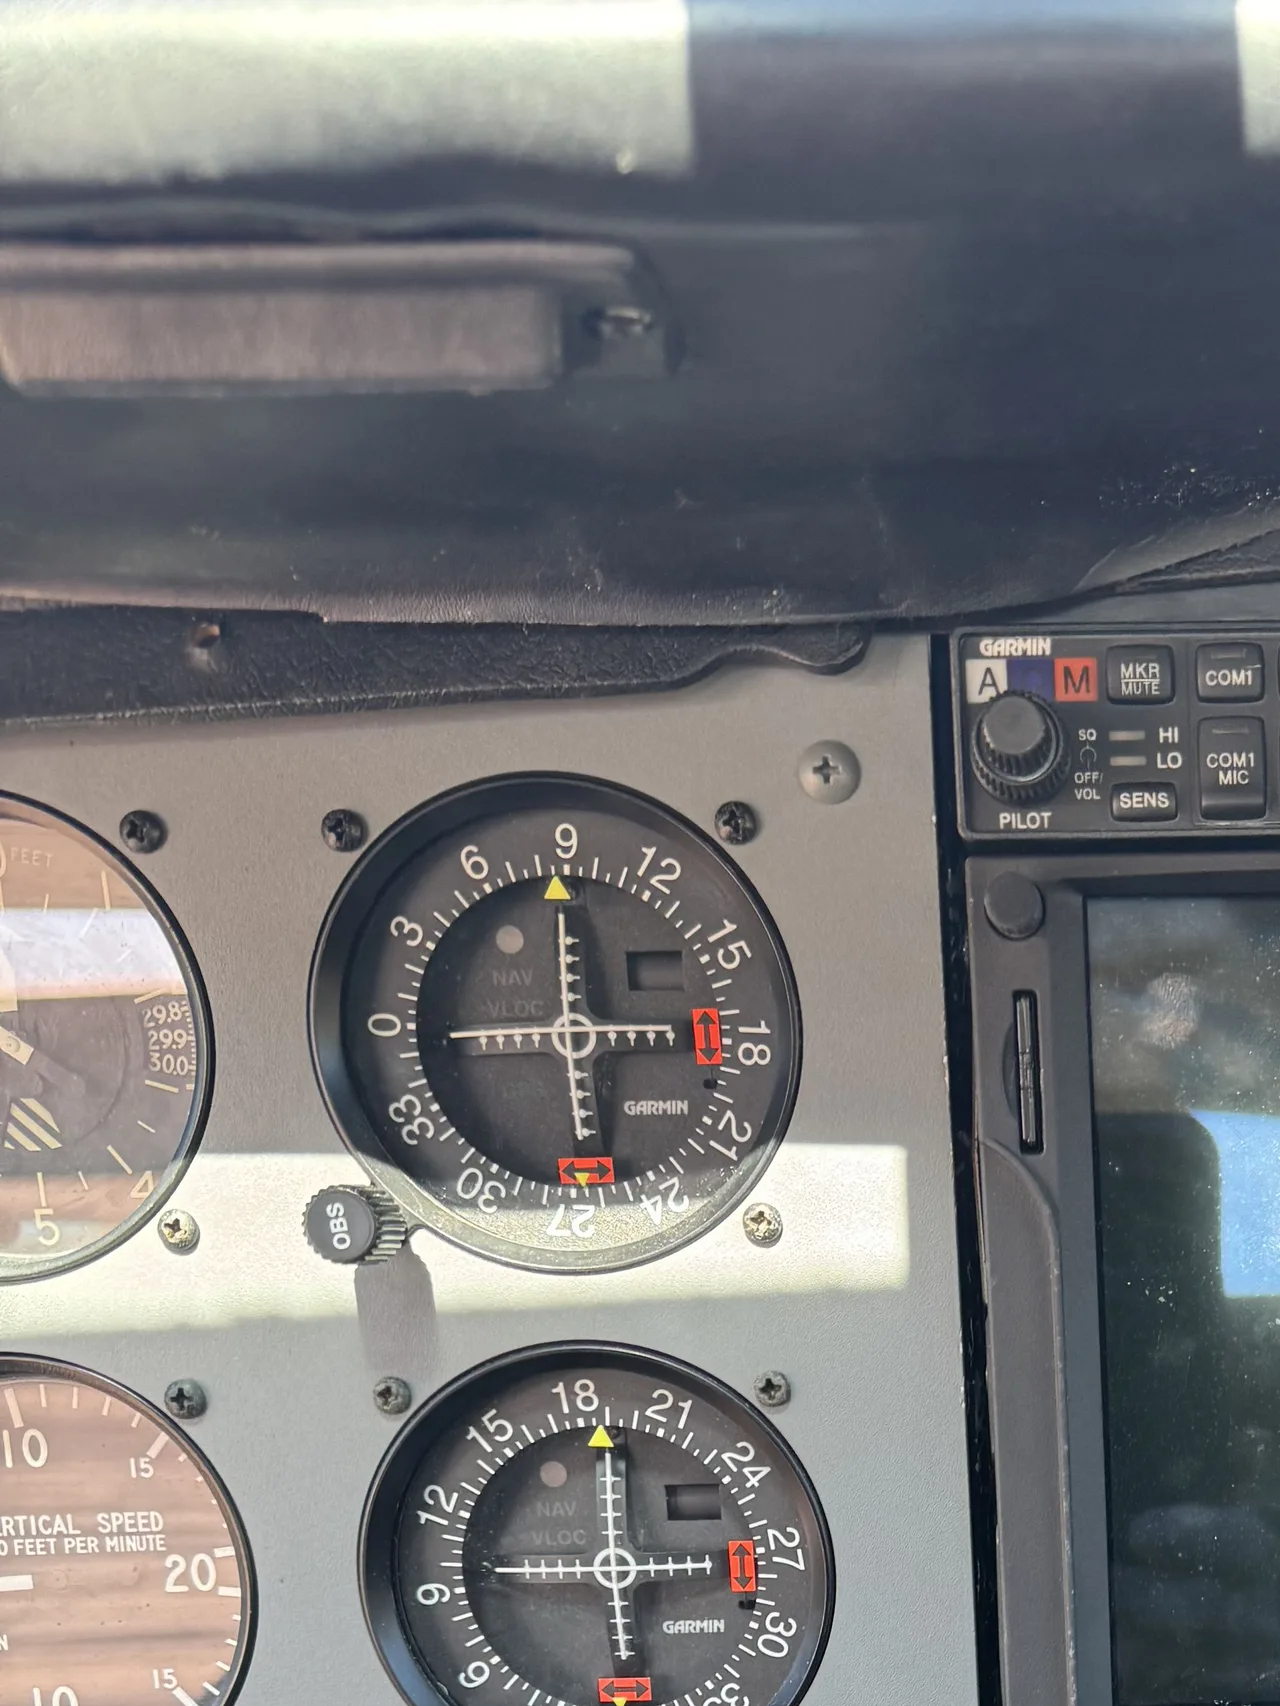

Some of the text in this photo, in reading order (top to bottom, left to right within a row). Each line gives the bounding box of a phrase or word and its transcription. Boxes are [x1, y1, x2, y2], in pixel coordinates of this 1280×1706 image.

[980, 638, 1051, 656] GARMIN
[1063, 666, 1091, 693] M
[1120, 664, 1160, 679] MKR
[1205, 670, 1253, 686] COM1
[978, 668, 999, 695] A
[1120, 680, 1160, 695] MUTE
[1159, 727, 1179, 743] HI
[1157, 753, 1182, 769] LO
[1074, 789, 1100, 800] VOL
[1119, 793, 1169, 808] SENS
[999, 812, 1051, 829] PILOT
[147, 1029, 188, 1049] 29.9
[624, 1099, 688, 1116] GARMIN
[326, 1201, 351, 1249] OBS
[552, 1378, 599, 1414] 18
[644, 1388, 693, 1429] 21
[466, 1408, 514, 1453] 15
[720, 1440, 772, 1489] 24
[97, 1511, 164, 1533] SPEED
[14, 1535, 166, 1556] FEET PER MINUTE
[164, 1552, 217, 1593] 20
[663, 1619, 725, 1635] GARMIN
